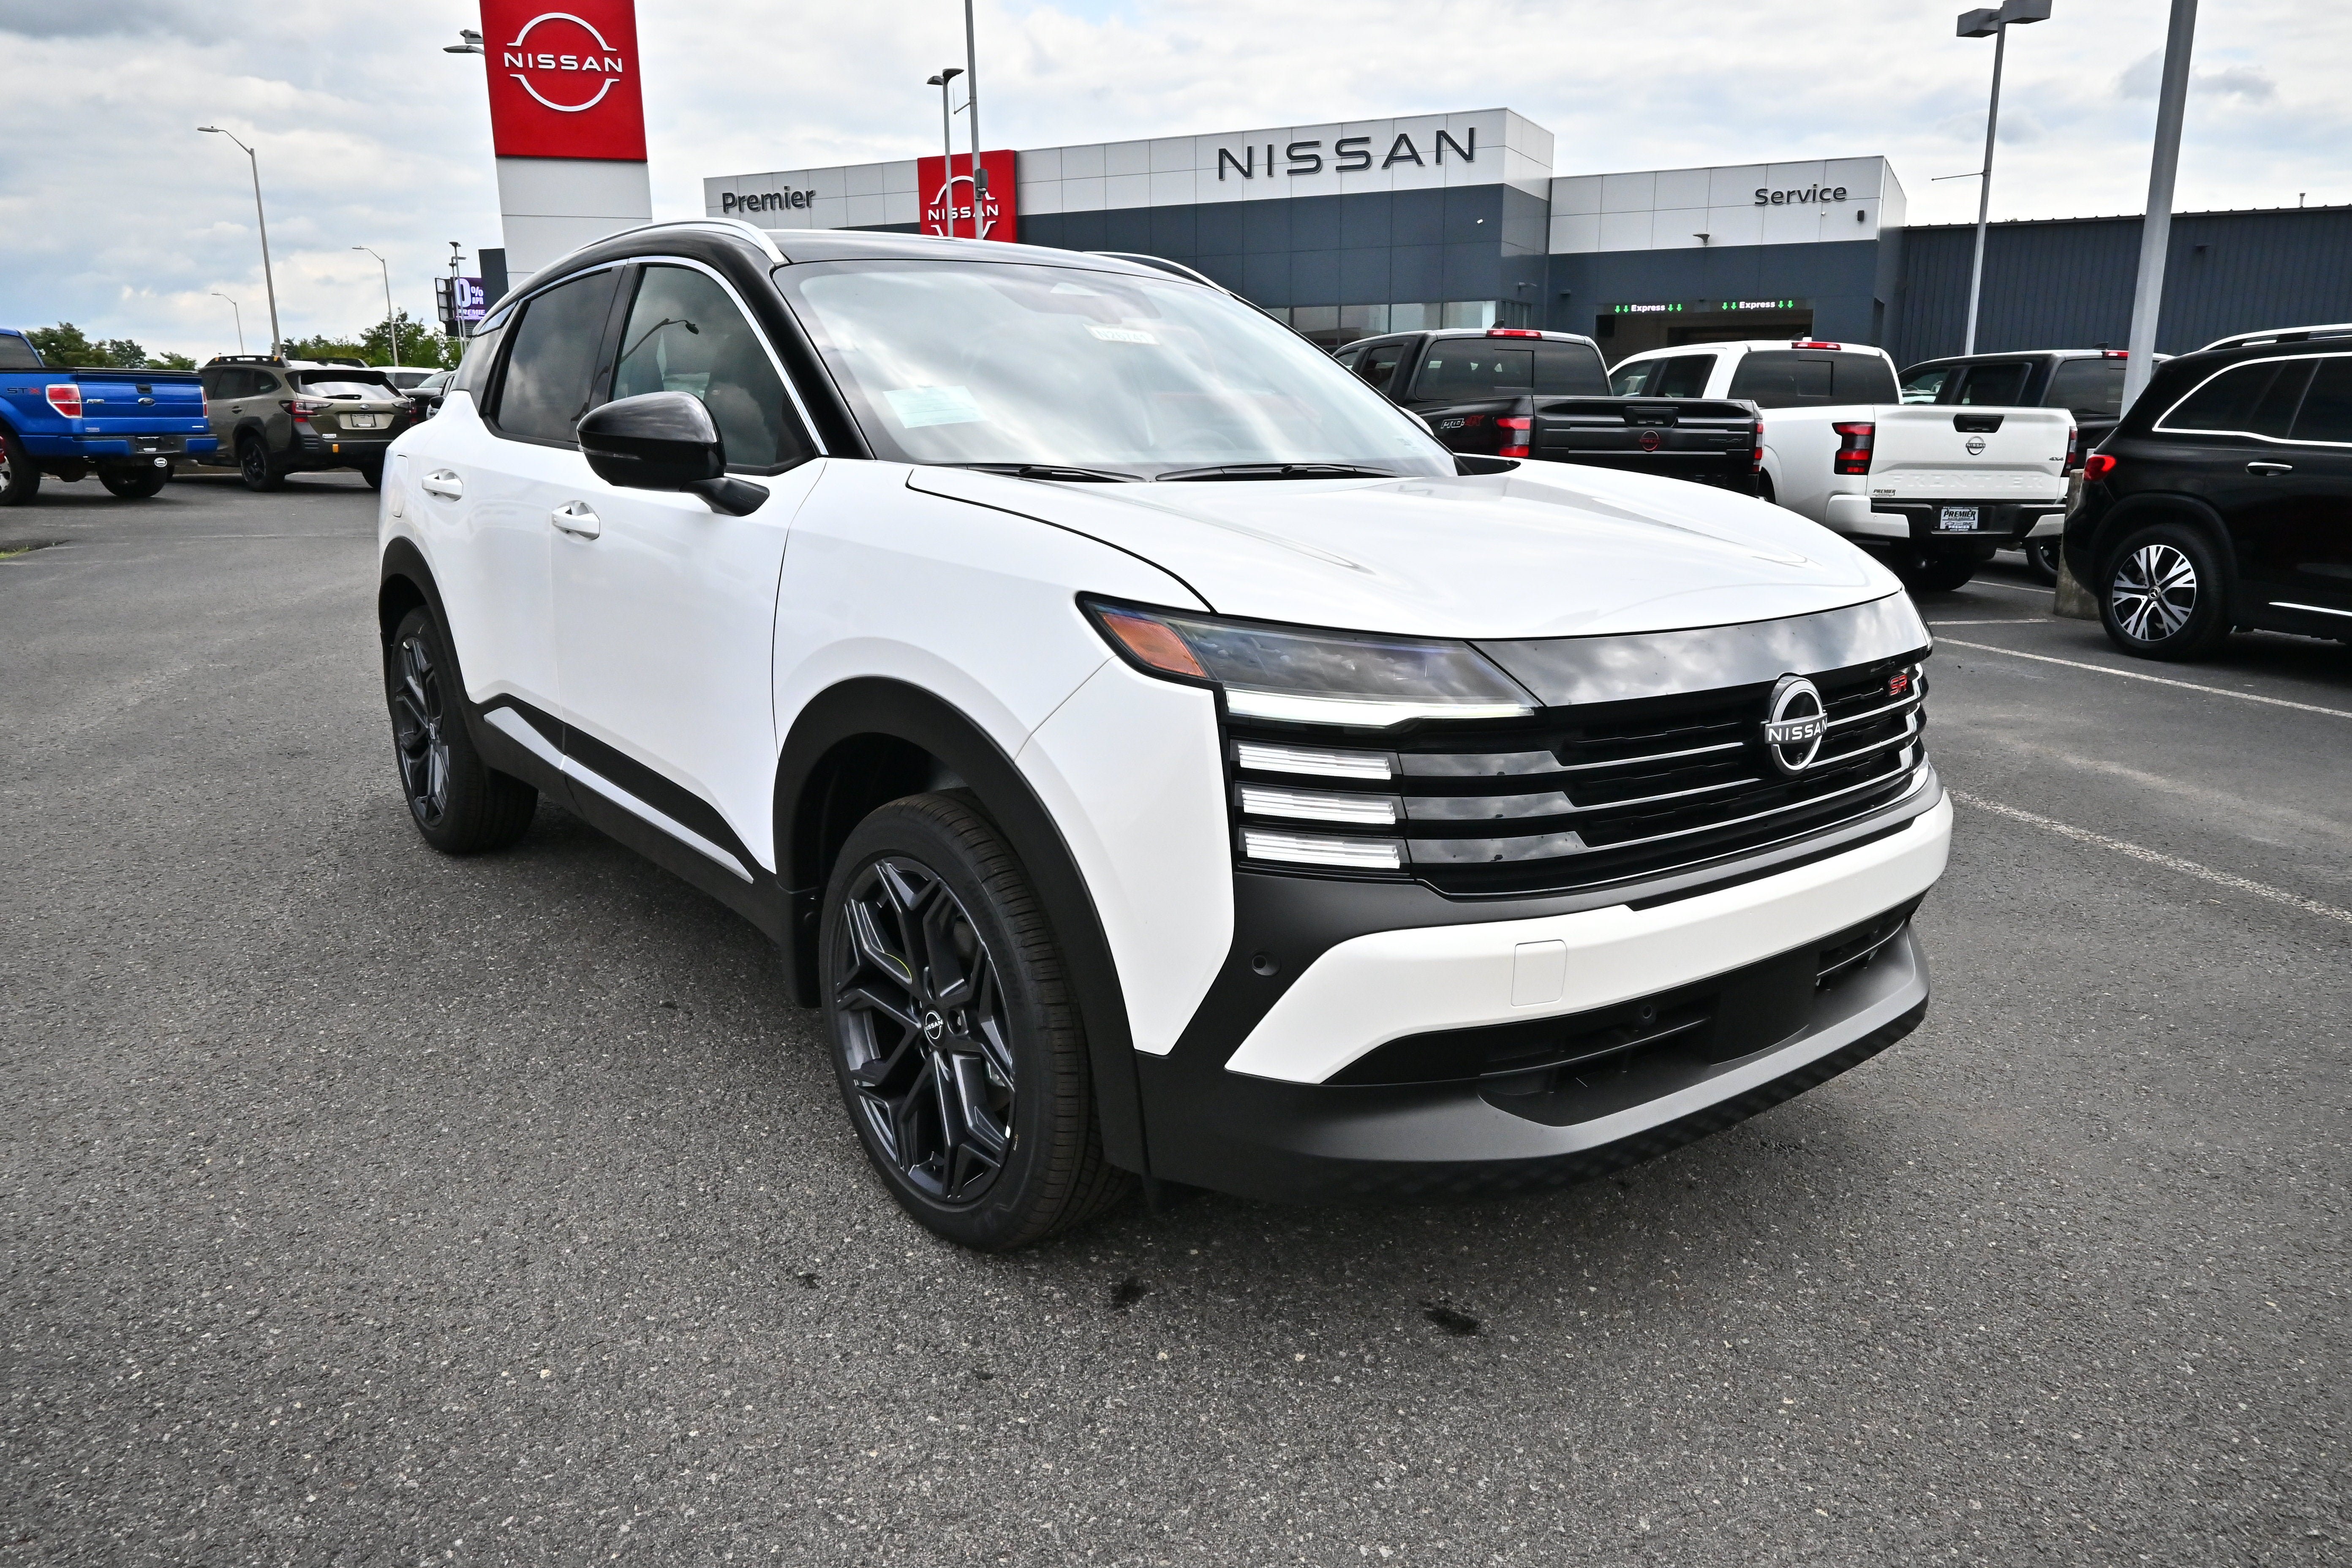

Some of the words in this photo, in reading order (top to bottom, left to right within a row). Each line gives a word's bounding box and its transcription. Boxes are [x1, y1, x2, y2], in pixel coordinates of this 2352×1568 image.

[504, 52, 623, 73] NISSAN
[1218, 127, 1475, 181] NISSAN
[722, 186, 816, 213] Premier
[1755, 183, 1847, 206] Service
[1631, 304, 1666, 313] Express
[1739, 301, 1775, 310] Express
[1889, 673, 1908, 696] SR
[1768, 717, 1828, 741] NISSAN
